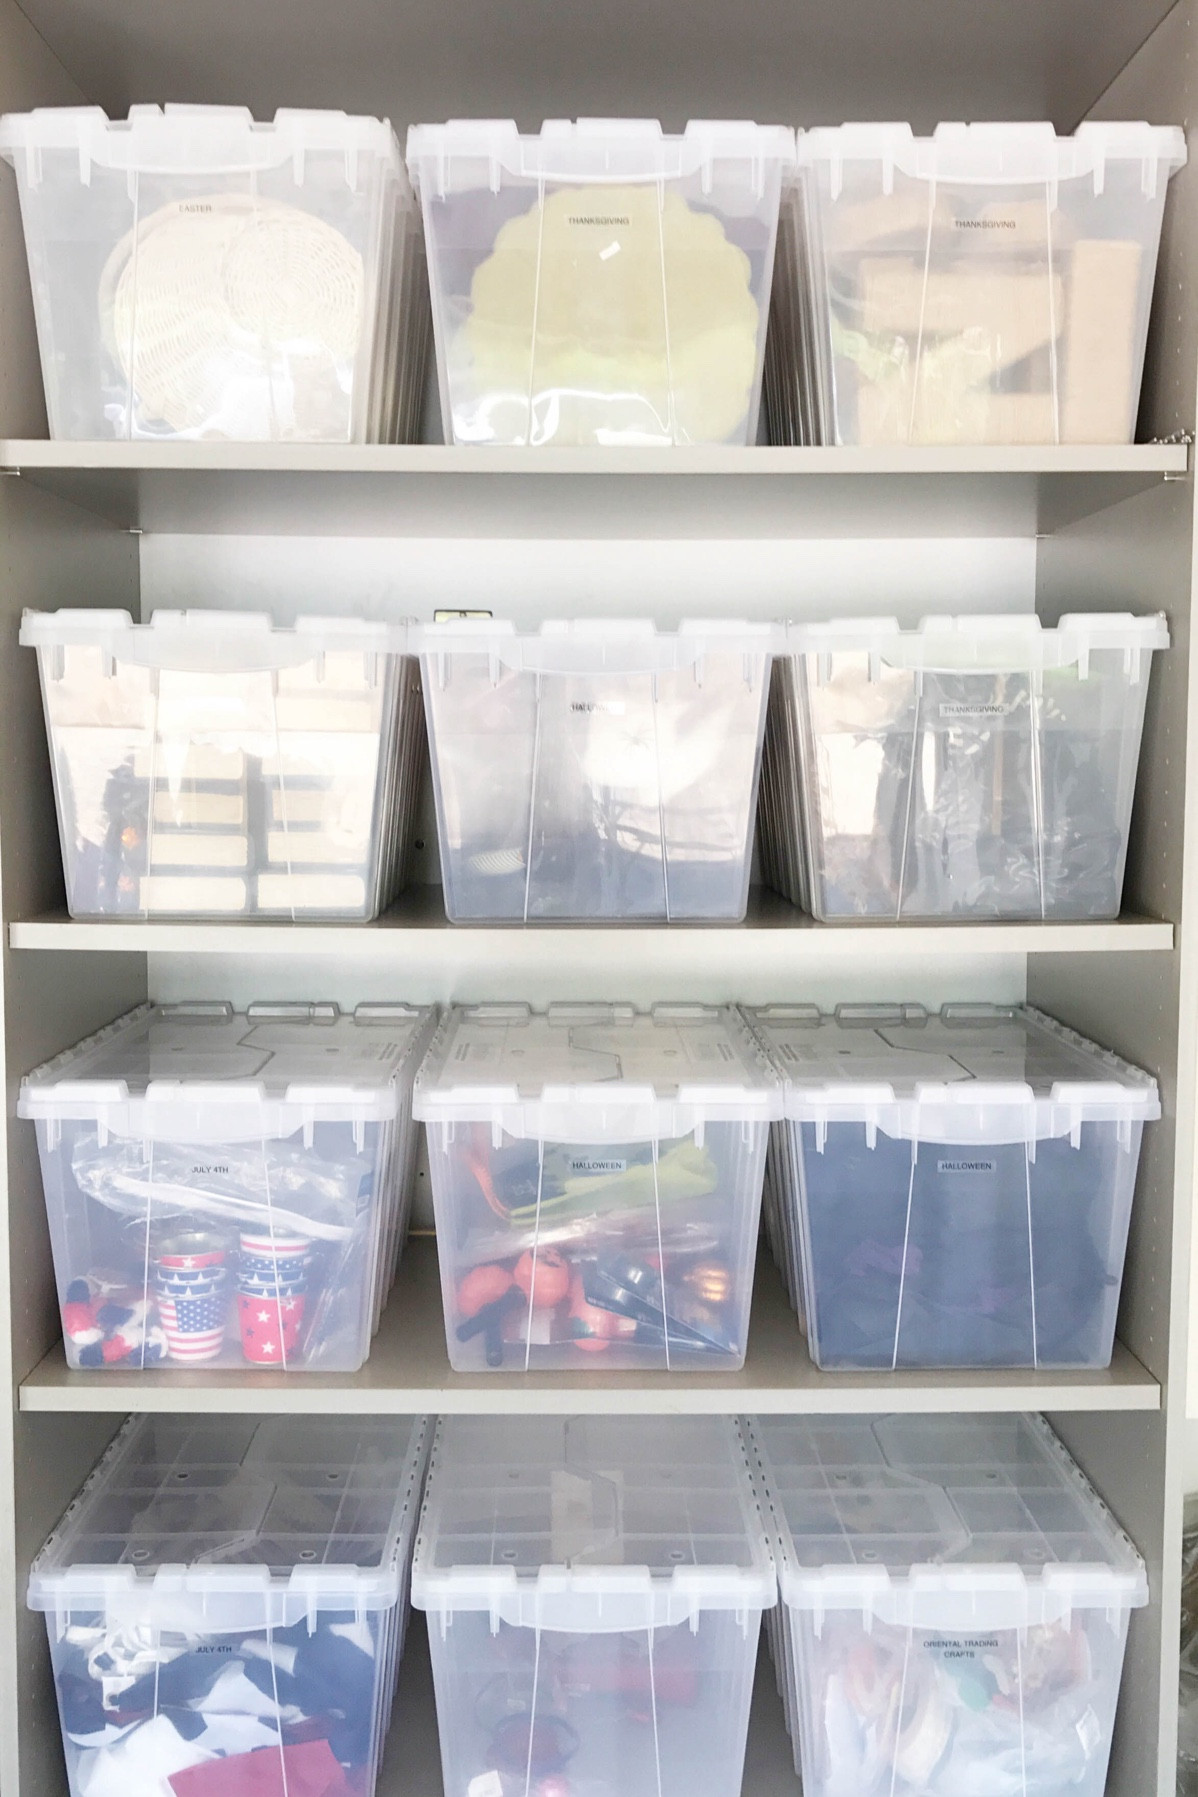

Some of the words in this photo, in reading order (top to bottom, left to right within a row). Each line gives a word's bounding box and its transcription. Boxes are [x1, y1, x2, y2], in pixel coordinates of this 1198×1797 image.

[178, 204, 212, 213] EASTER
[568, 216, 630, 225] THANKSGIVING
[955, 220, 1016, 229] THANKSGIVING
[943, 705, 1004, 713] THANKSGIVING
[191, 1165, 211, 1174] JULY
[213, 1165, 229, 1174] 4TH
[572, 1161, 622, 1170] HALLOWEEN
[941, 1162, 992, 1170] HALLOWEEN
[923, 1639, 962, 1648] ORIENTAL
[963, 1639, 999, 1648] TRADING
[195, 1645, 215, 1654] JULY
[217, 1645, 232, 1653] 4TH
[943, 1650, 976, 1659] CRAFTS
